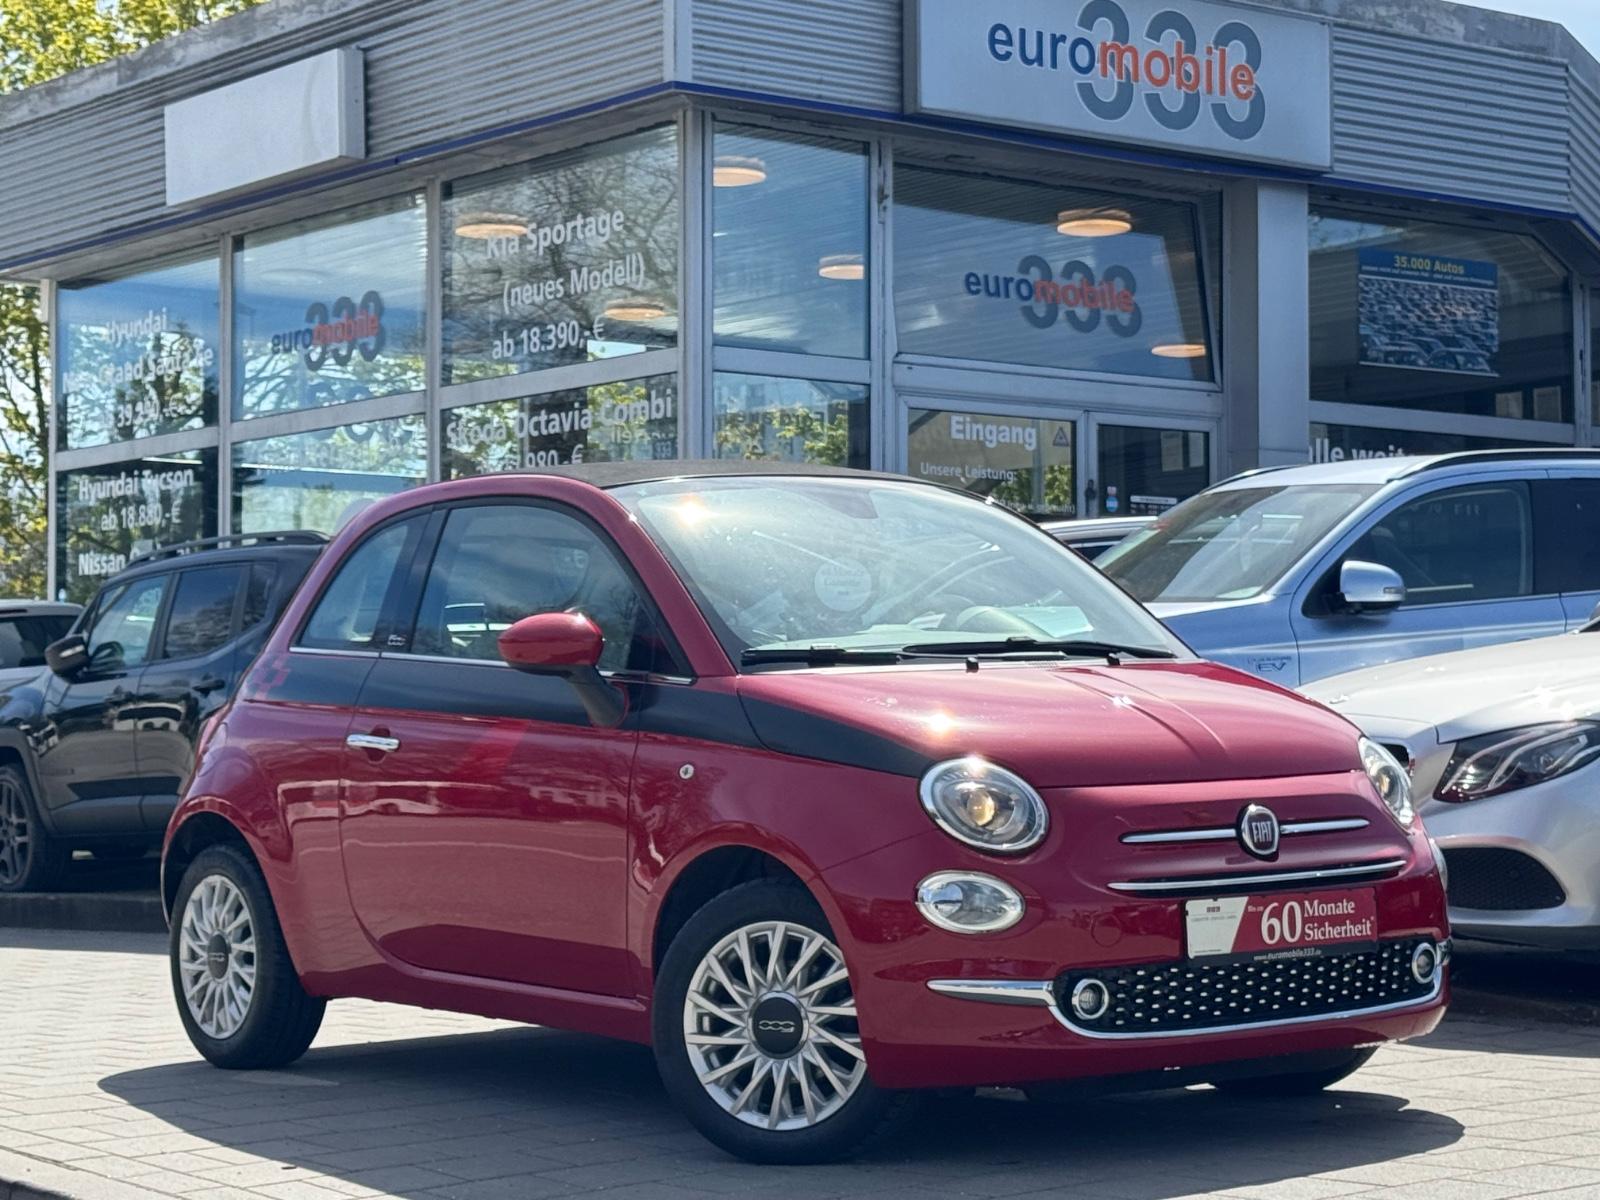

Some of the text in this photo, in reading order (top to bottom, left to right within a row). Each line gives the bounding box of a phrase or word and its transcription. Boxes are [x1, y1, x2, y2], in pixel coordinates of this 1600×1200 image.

[526, 209, 625, 255] Sportage
[1394, 255, 1465, 275] 35.000 Autos
[504, 252, 645, 314] (neues Modell)
[106, 307, 168, 348] Hyundai
[492, 329, 514, 360] ab
[515, 402, 593, 438] Octavia
[600, 387, 673, 427] Combi
[950, 415, 1037, 451] Eingang
[78, 468, 194, 506] Hyundai Tucson
[920, 461, 1018, 484] Unsere Leistung:
[101, 507, 118, 531] ab
[78, 551, 126, 576] Nissan
[1251, 820, 1274, 843] FIAT
[1261, 901, 1302, 945] 60
[1304, 899, 1355, 918] Monate
